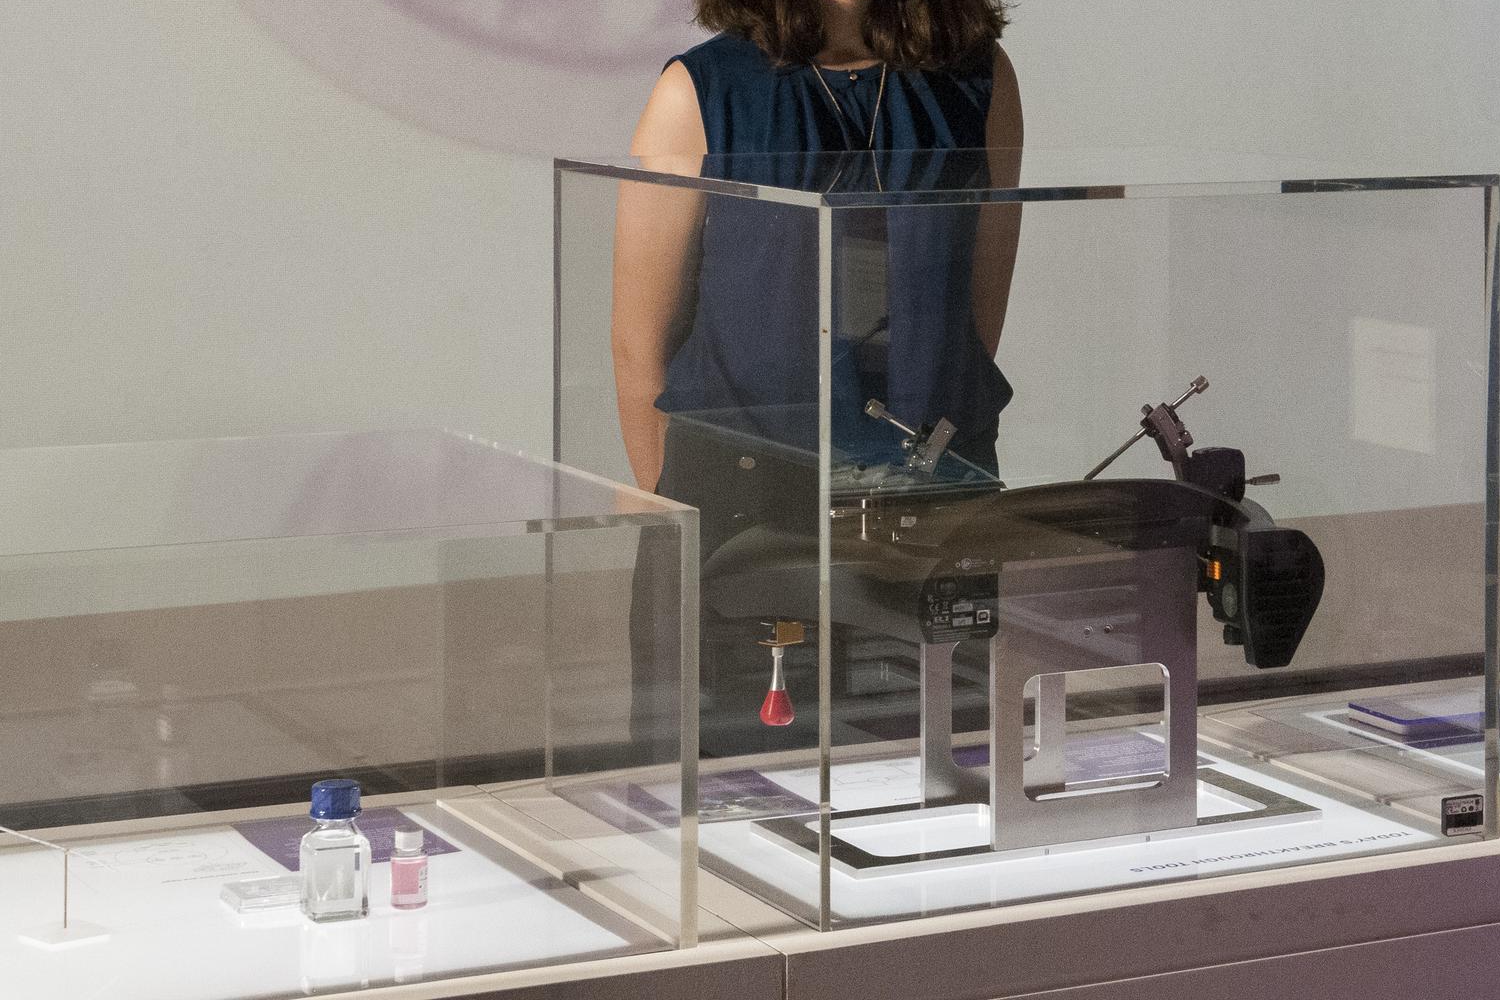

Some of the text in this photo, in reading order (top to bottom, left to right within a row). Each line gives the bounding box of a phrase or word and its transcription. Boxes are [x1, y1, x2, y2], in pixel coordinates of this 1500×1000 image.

[1130, 832, 1411, 873] TODAY'S BREAKTHROUGH TOOLS
